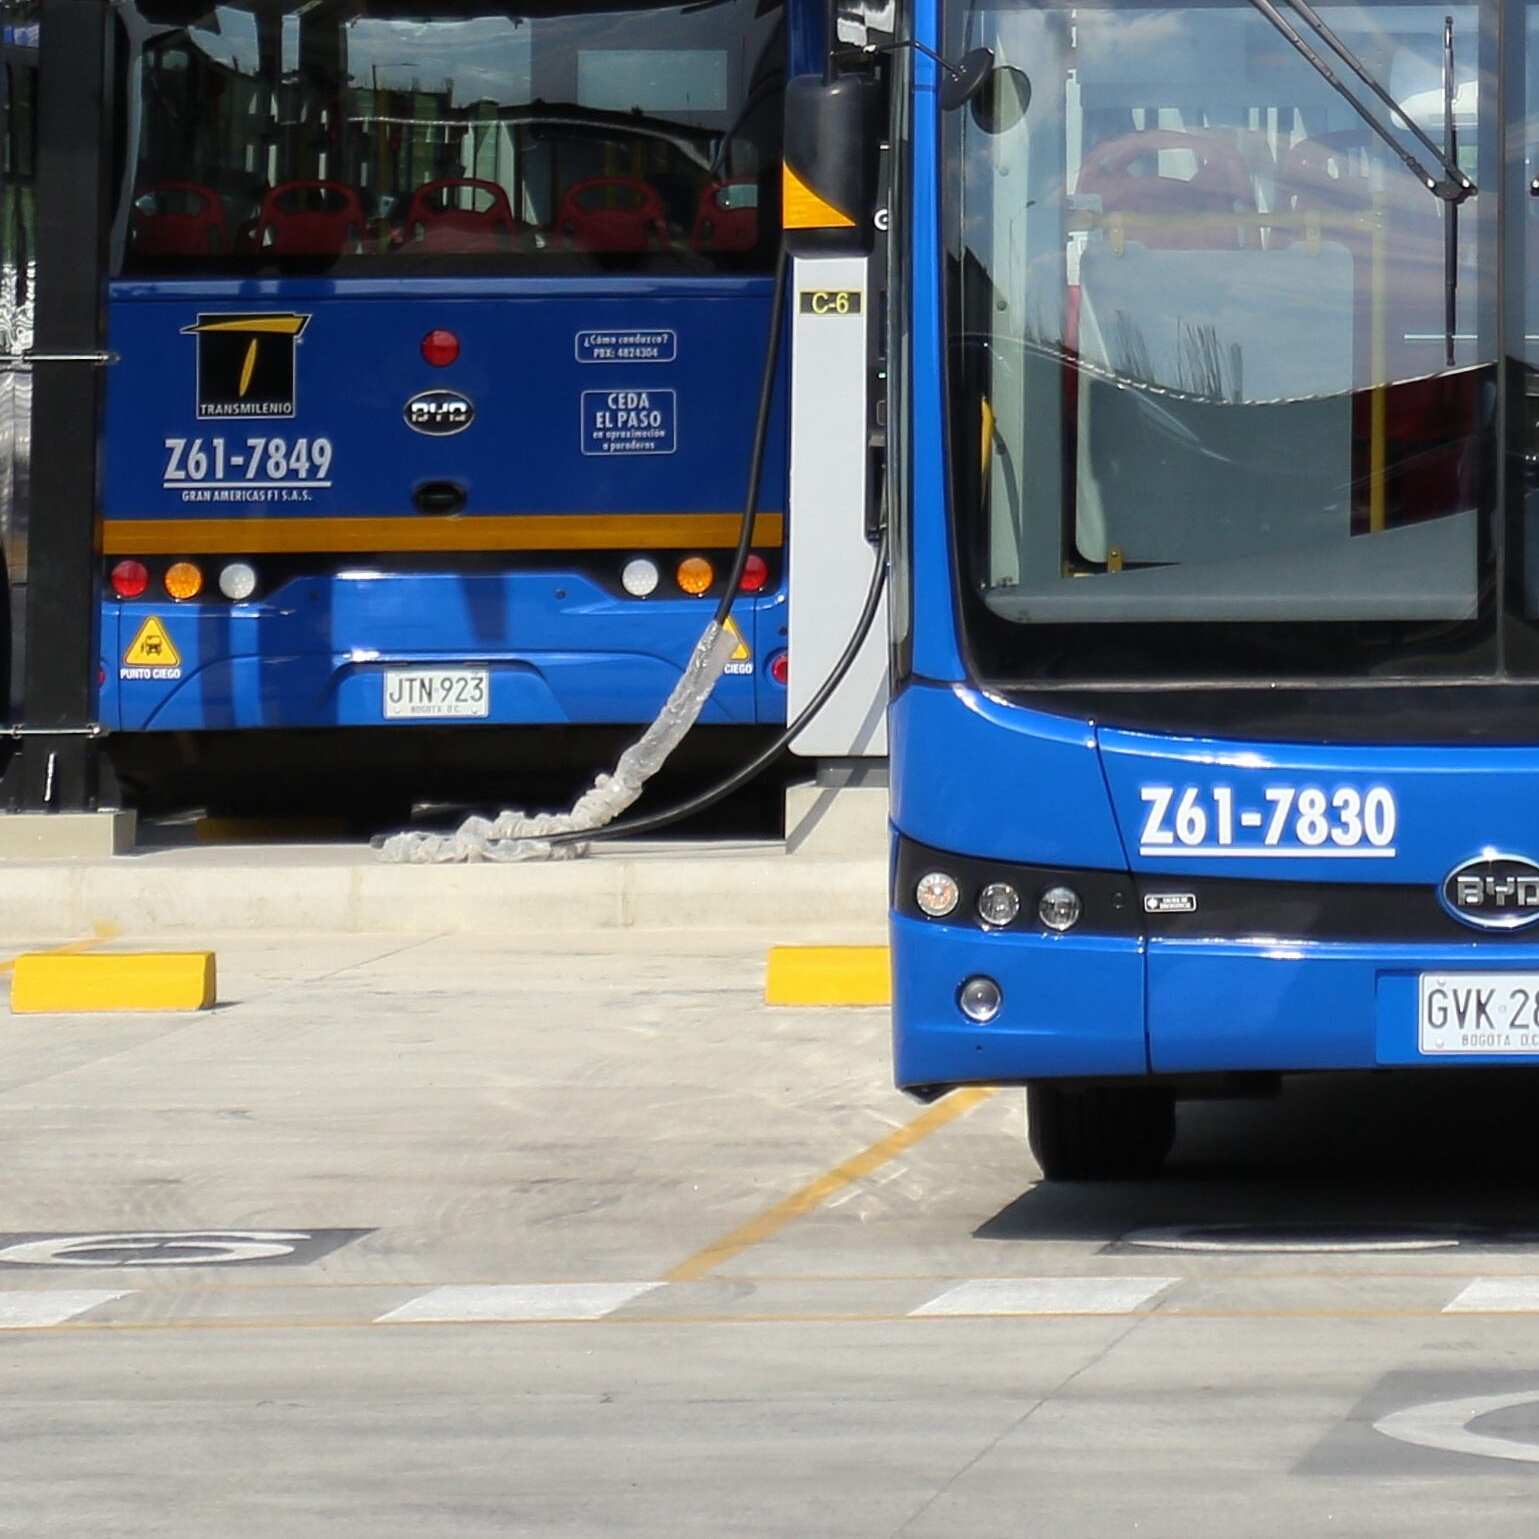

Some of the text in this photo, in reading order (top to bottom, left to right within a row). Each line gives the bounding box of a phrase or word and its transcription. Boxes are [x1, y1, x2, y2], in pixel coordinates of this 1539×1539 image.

[812, 292, 849, 314] C-6
[201, 402, 292, 415] TRANSMILENIO
[608, 392, 649, 409] CEDA
[596, 411, 661, 429] EL PASO
[163, 437, 332, 480] Z61-7849
[182, 490, 211, 502] GRAN
[213, 490, 265, 501] AMERICAS
[282, 490, 312, 501] S.A.S.
[120, 668, 181, 679] PUNTO CIEGO
[724, 663, 753, 674] CIEGO
[389, 677, 484, 703] JTN 923
[1140, 787, 1396, 847] Z61-7830
[1427, 988, 1495, 1030] GVK
[1462, 1033, 1511, 1046] BOGOTA
